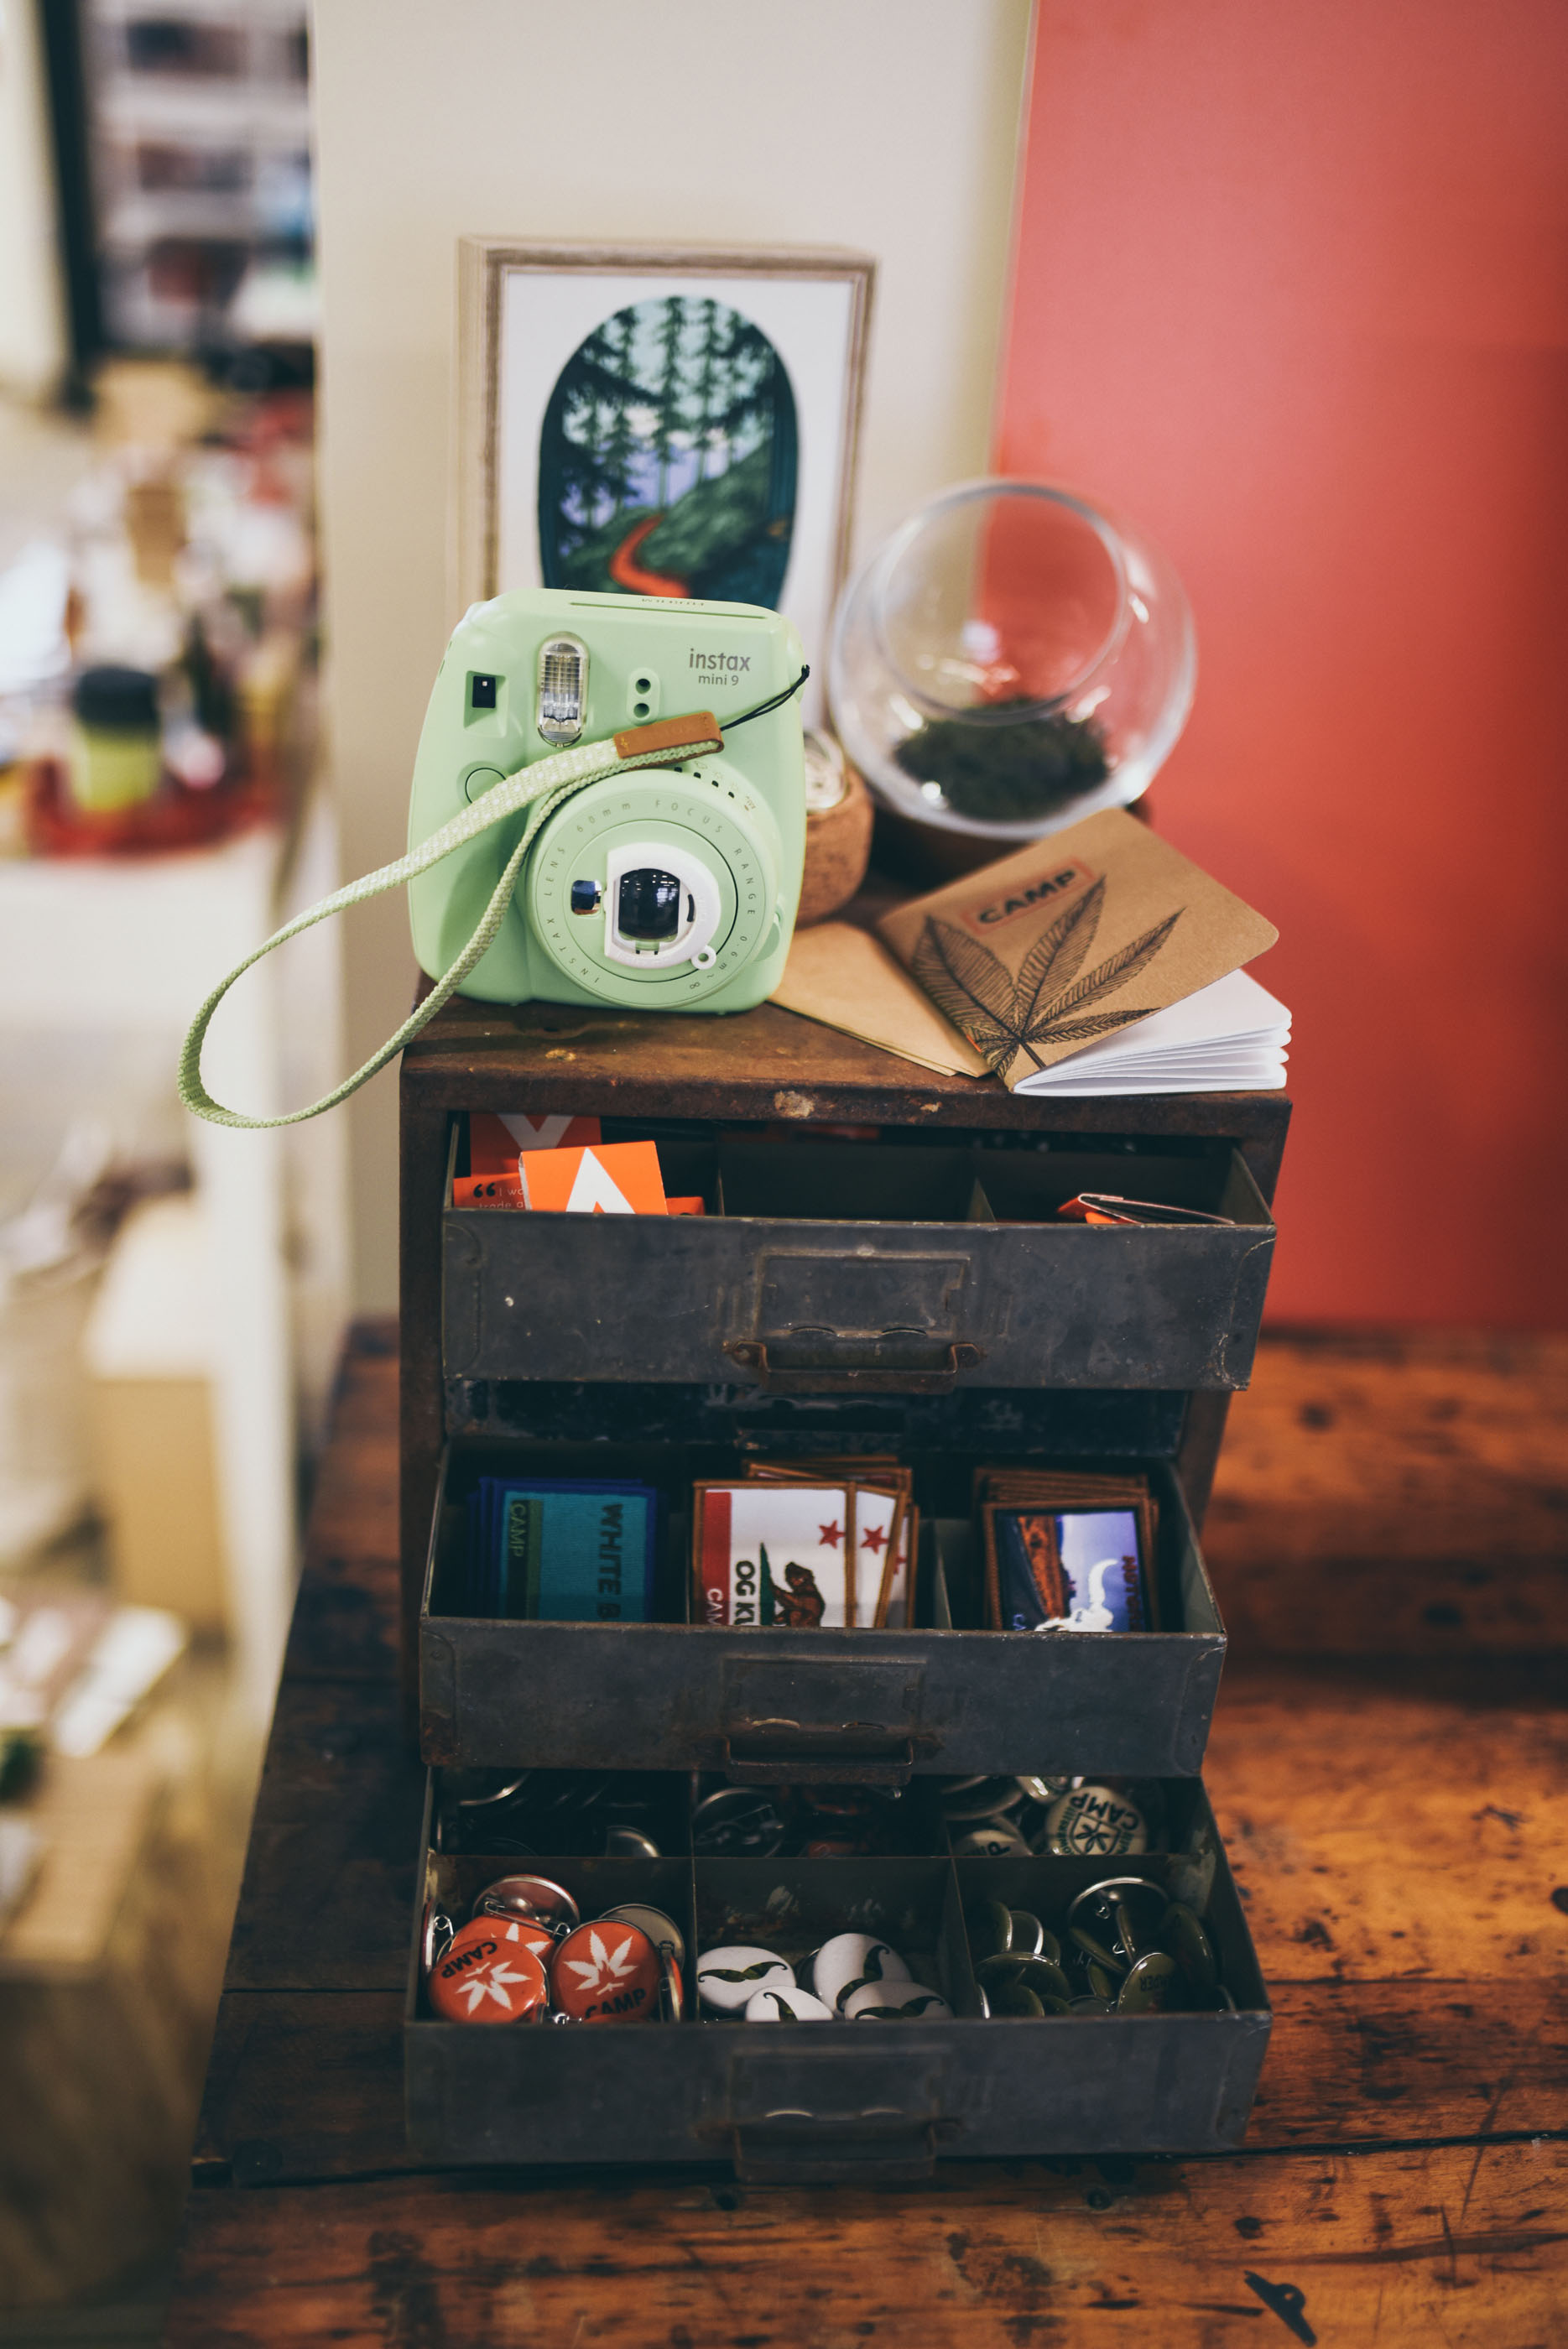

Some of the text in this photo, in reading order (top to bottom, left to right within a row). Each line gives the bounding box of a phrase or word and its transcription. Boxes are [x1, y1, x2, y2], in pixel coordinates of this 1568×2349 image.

[690, 648, 751, 672] instax
[698, 674, 739, 686] mini 9
[655, 799, 723, 833] FOCUS
[544, 846, 565, 897] LENS
[733, 847, 757, 915] RANGE
[978, 870, 1076, 924] CAMP
[546, 918, 600, 983] INSTAX
[509, 1503, 526, 1558] CAMP
[597, 1503, 623, 1596] WHITE
[736, 1560, 756, 1596] OG
[1070, 1794, 1139, 1831] CAMP
[441, 1941, 497, 1979] CAMP
